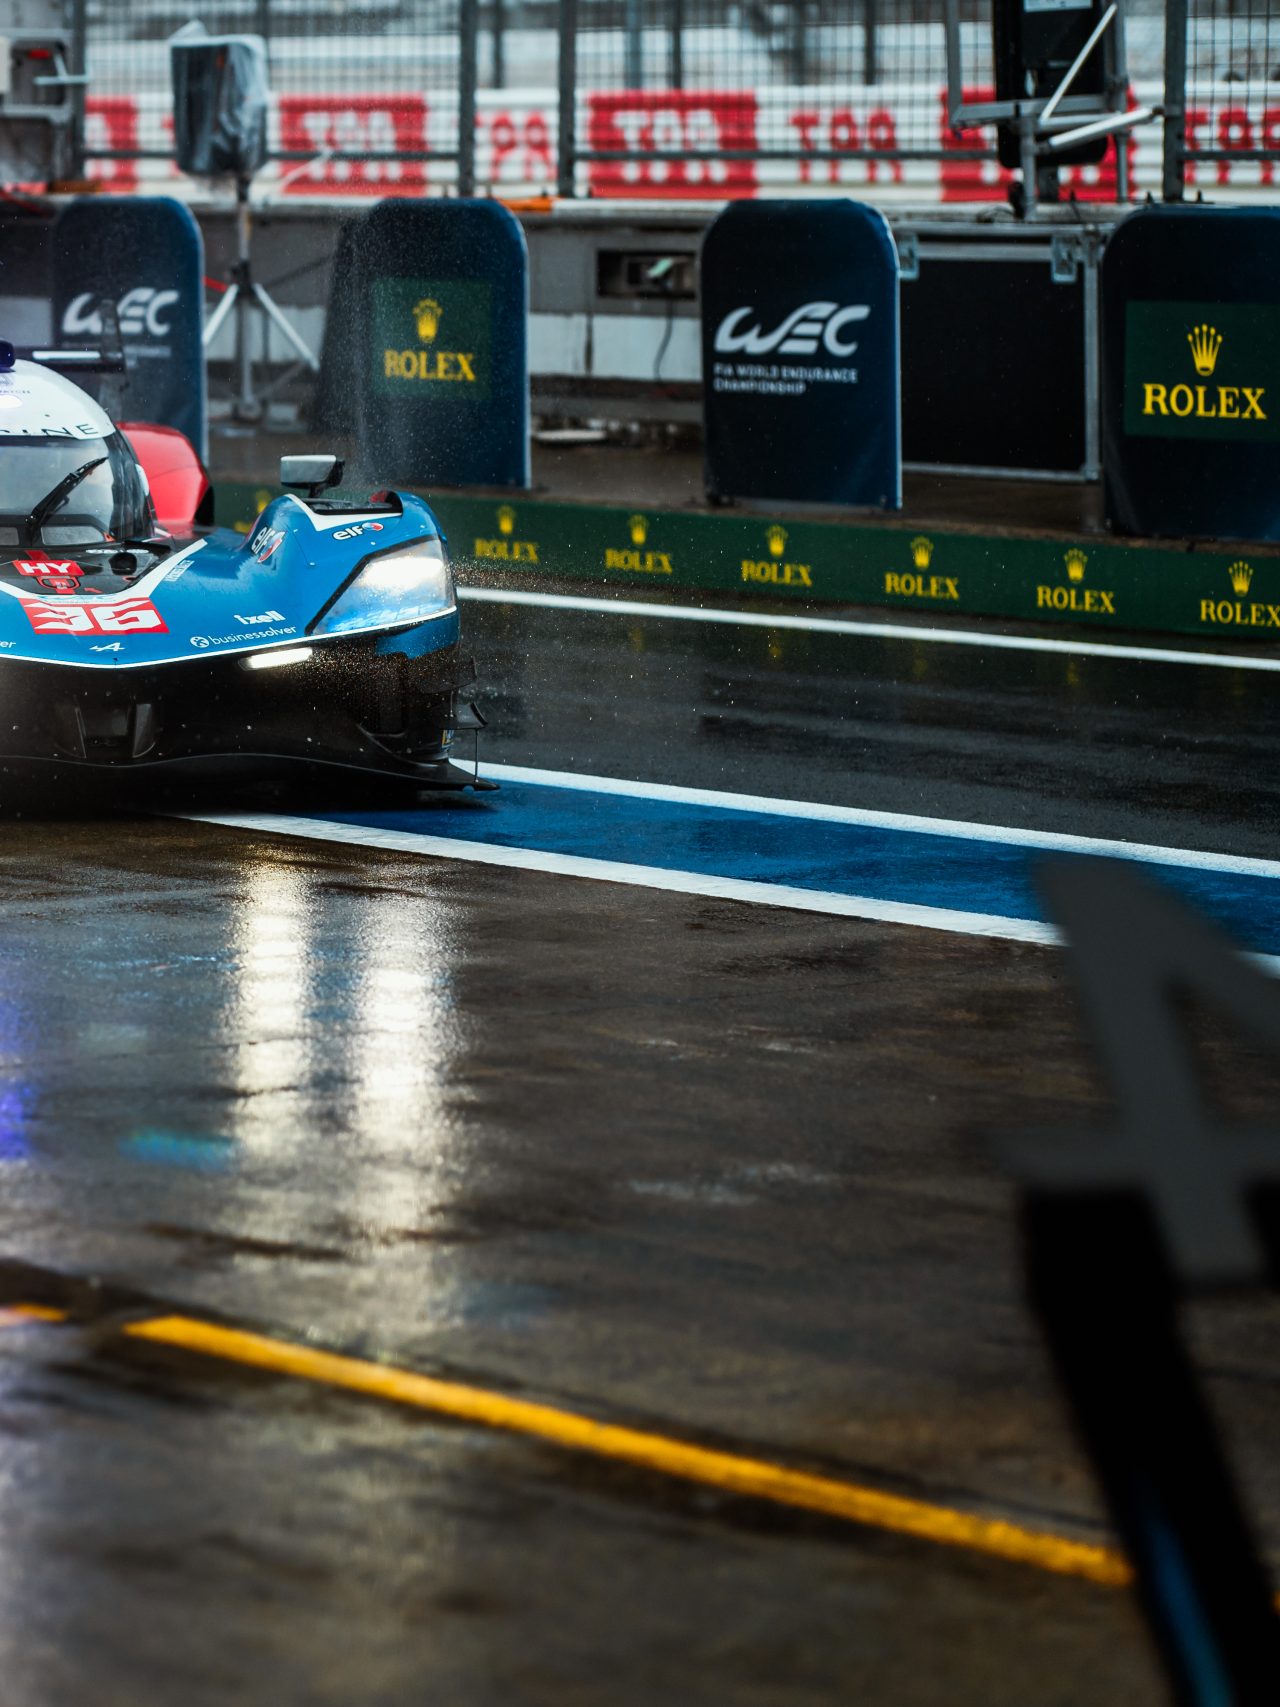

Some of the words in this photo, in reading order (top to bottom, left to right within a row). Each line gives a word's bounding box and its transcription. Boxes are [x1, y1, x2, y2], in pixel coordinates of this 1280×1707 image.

[714, 301, 870, 357] WEC
[385, 350, 475, 381] ROLEX
[738, 364, 778, 379] WORLD
[781, 366, 858, 383] ENDURANCE
[1142, 383, 1266, 420] ROLEX
[475, 537, 538, 563] ROLEX
[605, 547, 673, 575] ROLEX
[21, 562, 72, 574] HY
[741, 558, 812, 587] ROLEX
[885, 572, 959, 601] ROLEX
[1037, 585, 1115, 615] ROLEX
[24, 600, 162, 631] 36
[234, 610, 286, 625] ixell
[1200, 598, 1280, 629] ROLEX
[207, 626, 297, 645] businessolver
